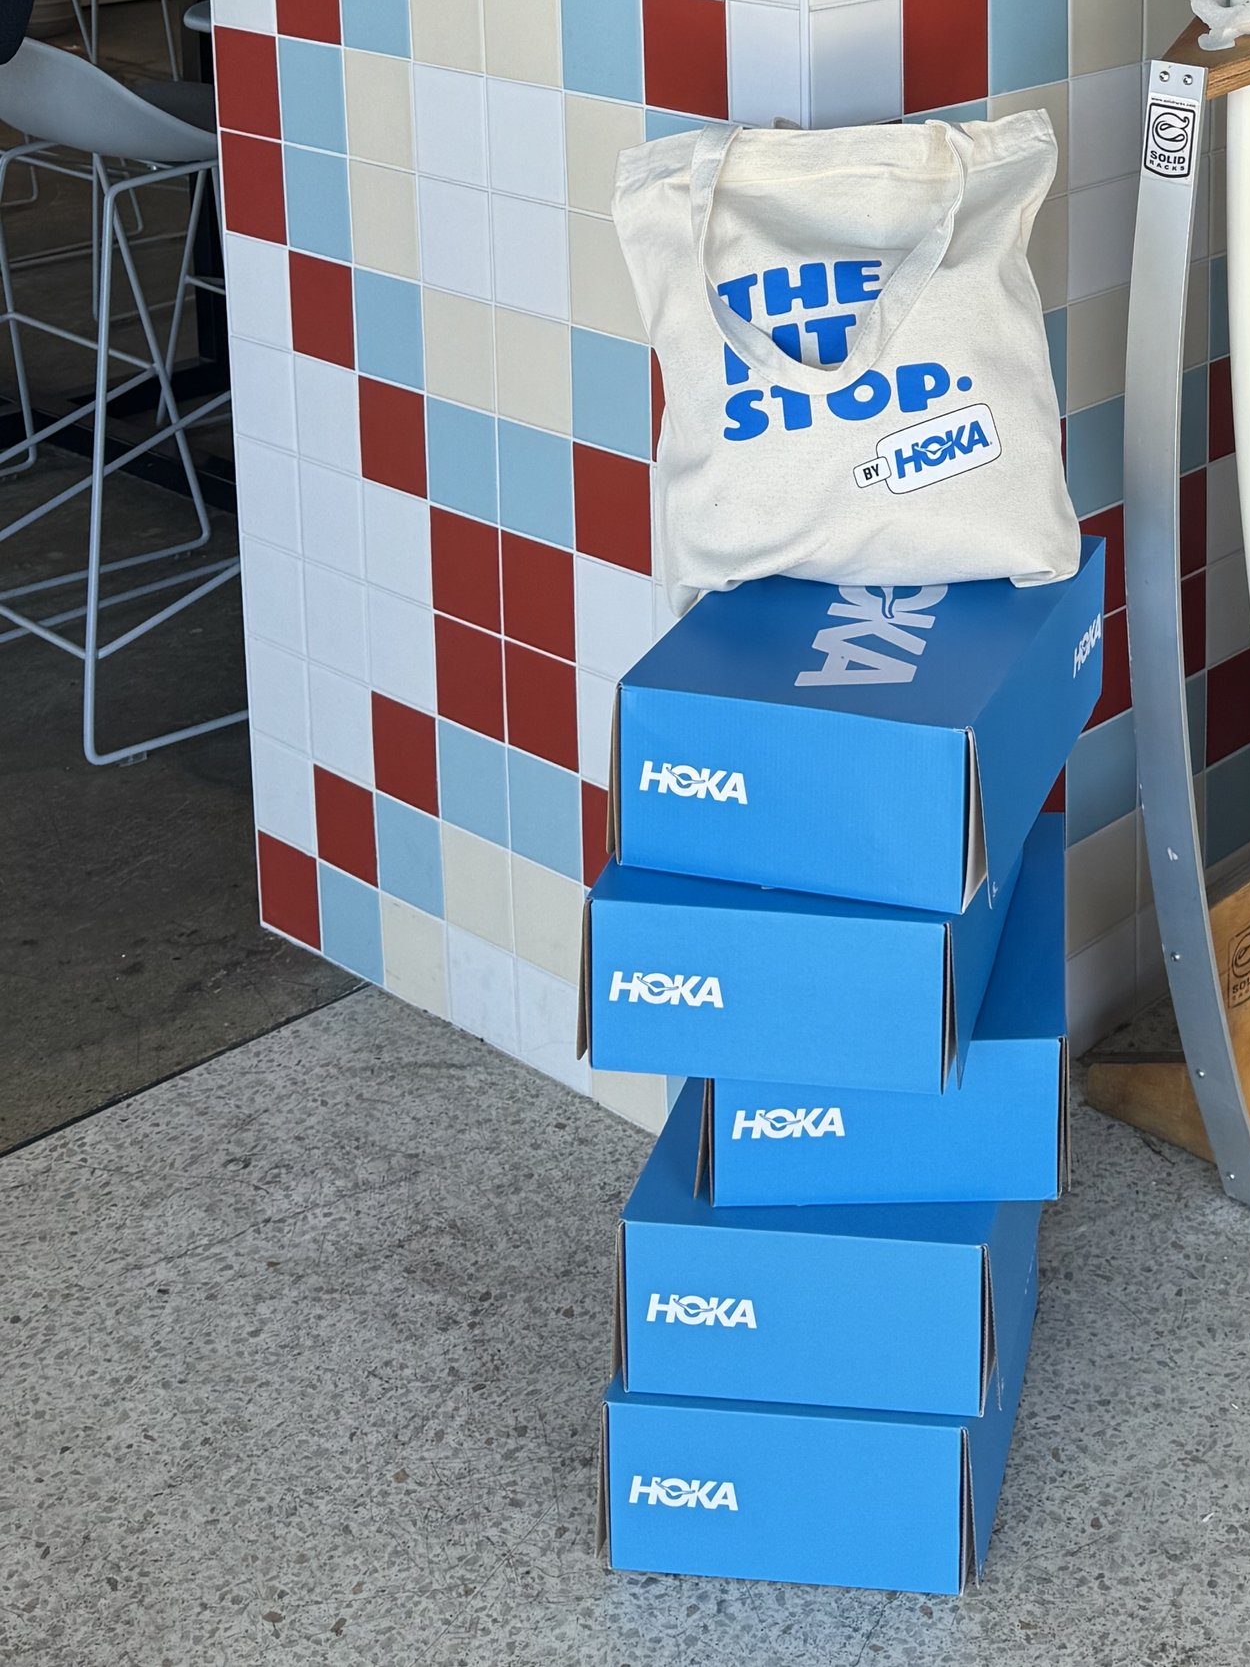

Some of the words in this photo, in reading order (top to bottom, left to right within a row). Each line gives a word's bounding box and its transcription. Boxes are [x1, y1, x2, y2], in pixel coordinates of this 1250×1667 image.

[1149, 159, 1186, 172] RACKS
[1150, 150, 1186, 165] SOLID
[718, 260, 883, 323] THE
[862, 463, 880, 482] BY
[895, 420, 990, 480] HOKA
[1073, 613, 1102, 679] HOKA
[639, 760, 748, 805] HOKA
[608, 970, 724, 1008] HOKA
[732, 1106, 845, 1140] HOKA
[646, 1293, 757, 1329] HOKA
[628, 1475, 739, 1511] HOKA
